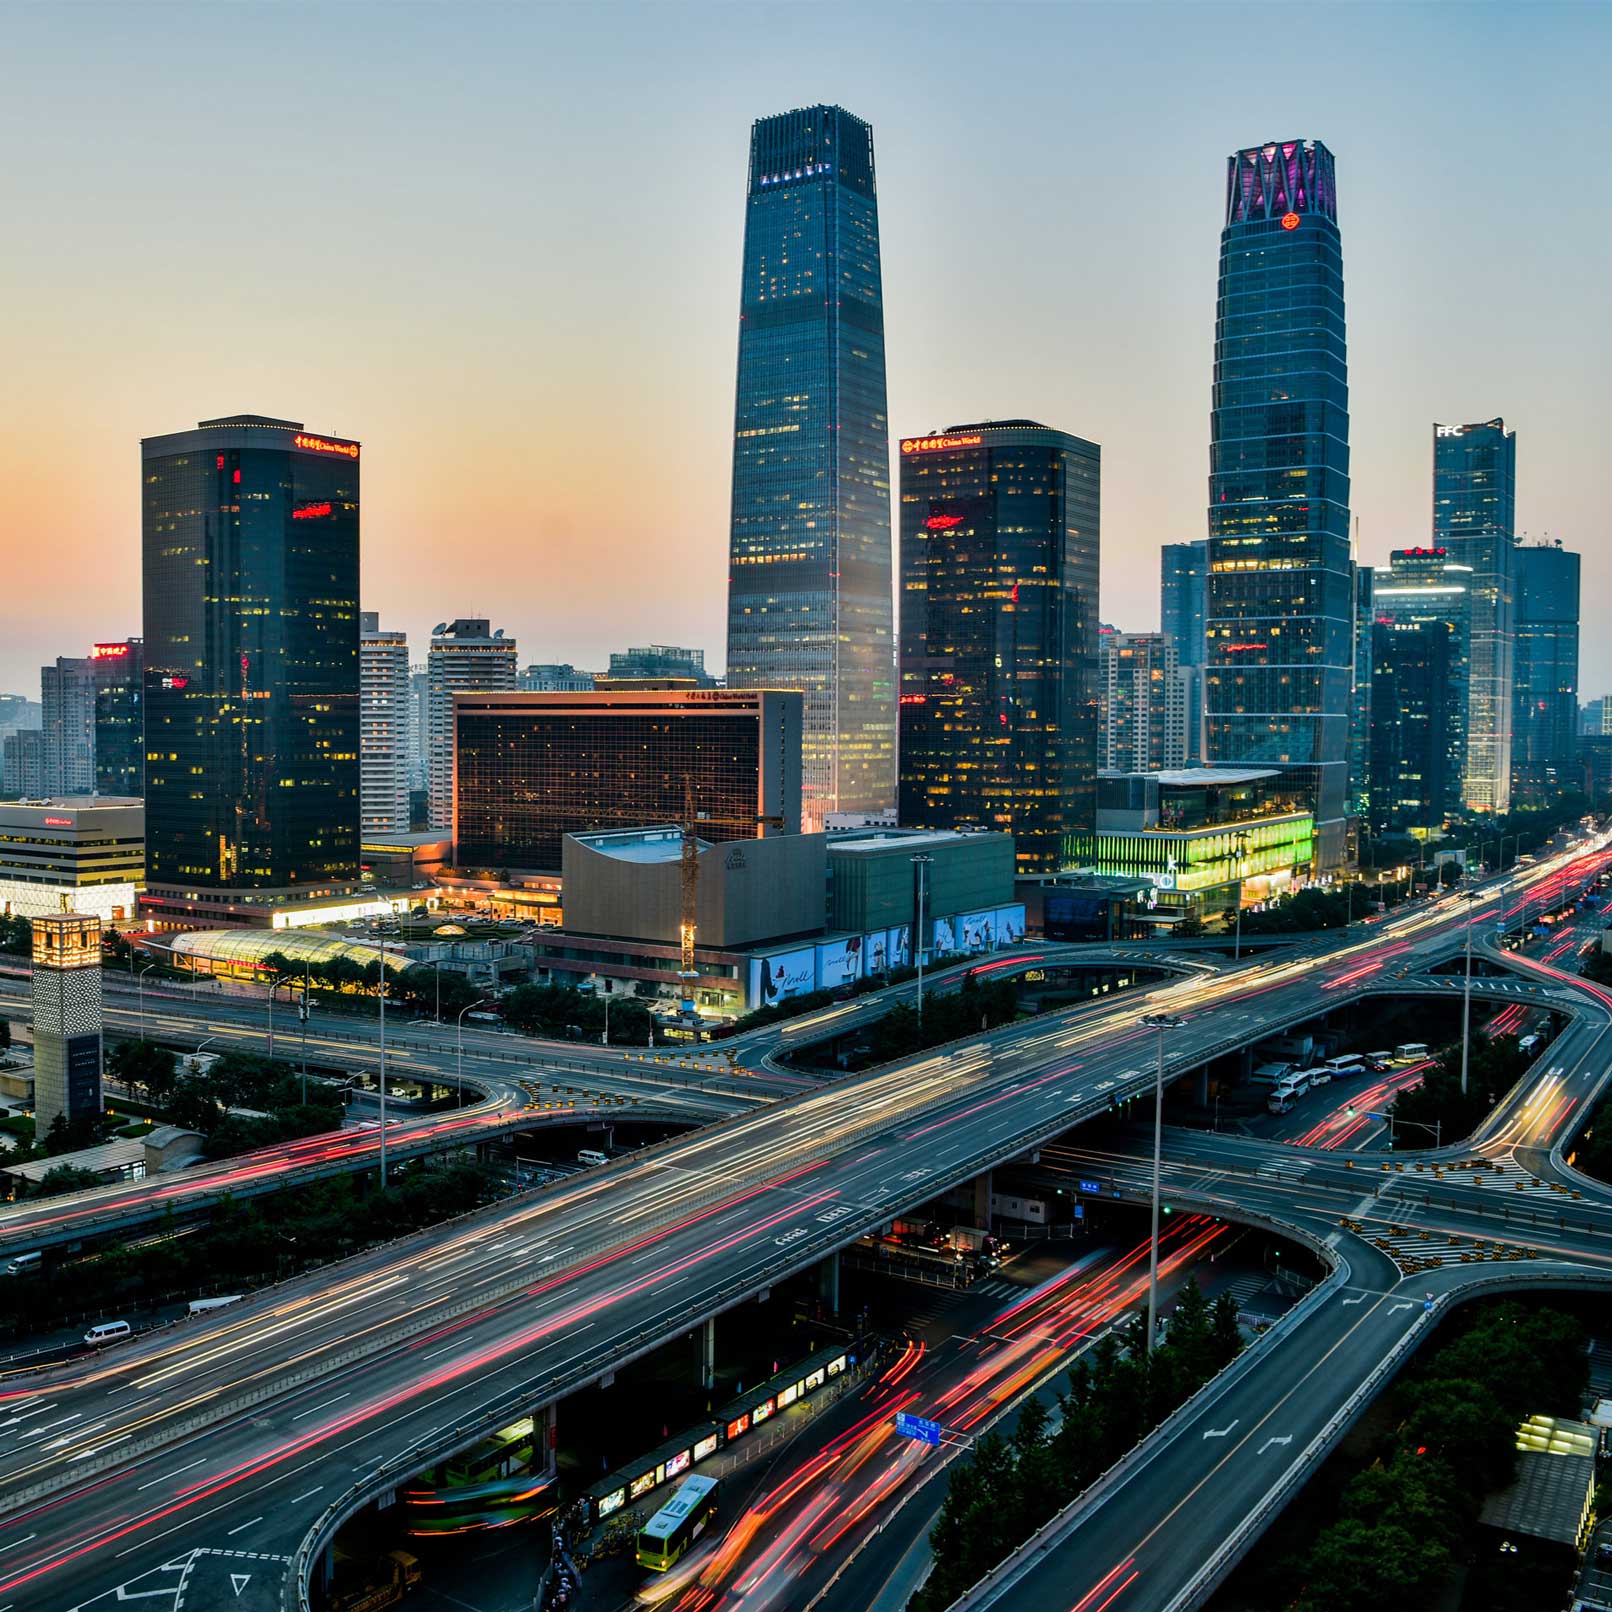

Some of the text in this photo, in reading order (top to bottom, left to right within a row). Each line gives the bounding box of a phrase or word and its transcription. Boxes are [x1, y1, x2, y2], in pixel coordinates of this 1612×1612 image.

[1437, 425, 1463, 437] FFC
[943, 436, 981, 446] China World
[320, 442, 349, 454] China World
